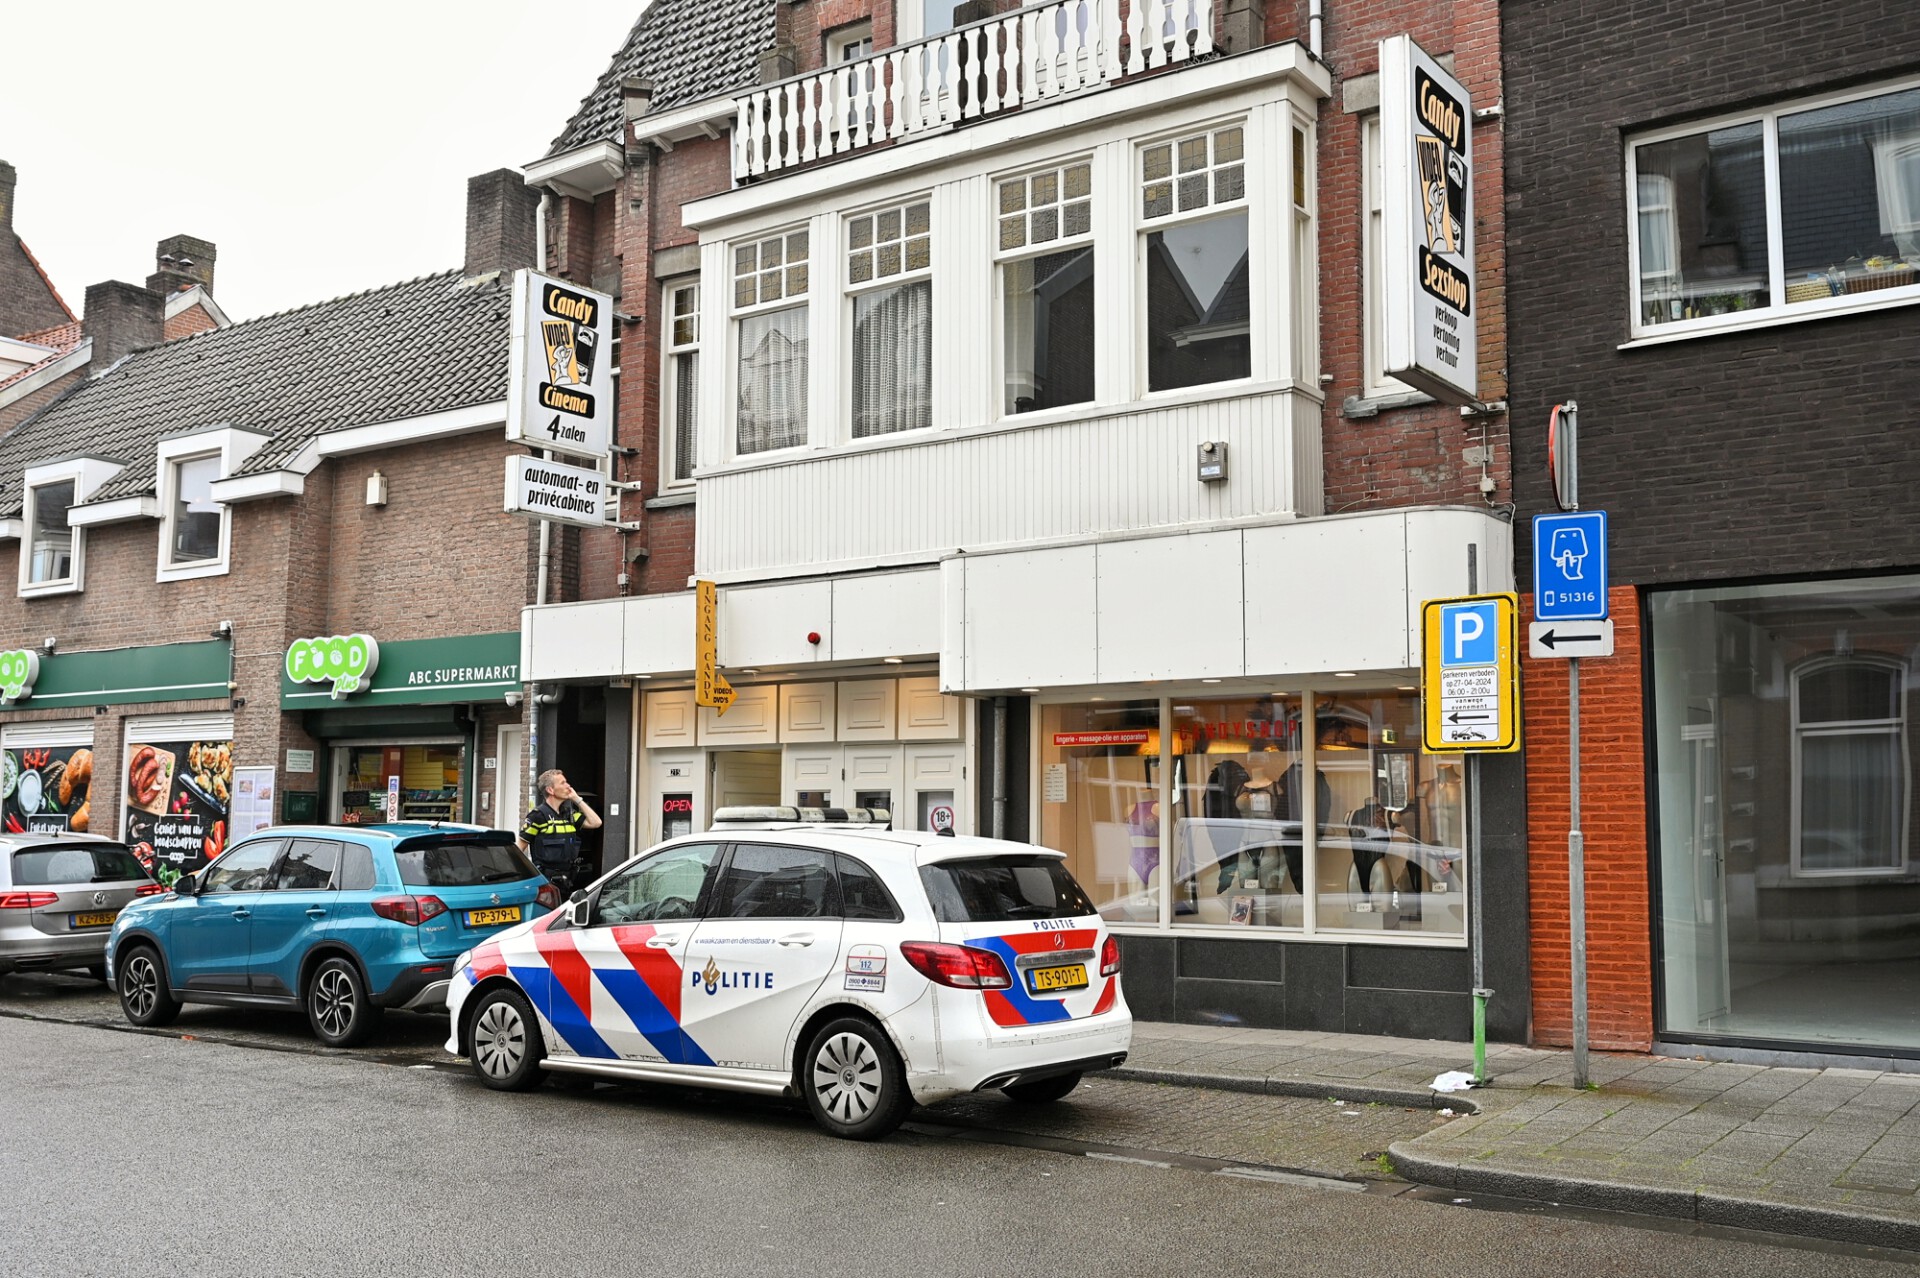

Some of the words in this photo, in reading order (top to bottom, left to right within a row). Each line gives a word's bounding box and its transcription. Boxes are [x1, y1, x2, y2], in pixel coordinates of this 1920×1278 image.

[1421, 79, 1460, 148] Candy
[1424, 253, 1467, 311] Sexshop
[549, 289, 593, 324] Candy
[1435, 305, 1458, 331] verkoop
[545, 323, 570, 346] VIDEO
[1433, 323, 1460, 352] vertoning
[1436, 345, 1458, 368] verhuur
[544, 386, 588, 414] Cinema
[547, 414, 560, 440] 4
[560, 425, 586, 442] zalen
[525, 468, 584, 491] automaat-
[585, 480, 599, 495] en
[527, 488, 595, 515] privécabines
[1560, 592, 1595, 603] 51316
[703, 586, 711, 643] INGANG
[1455, 612, 1484, 659] P
[294, 645, 362, 672] FOOD
[408, 670, 432, 685] ABC
[434, 665, 518, 683] SUPERMARKT
[703, 652, 711, 699] CANDY
[1443, 671, 1468, 679] parkeren
[1468, 669, 1496, 678] verboden
[333, 675, 359, 698] plus
[713, 687, 733, 695] VIDEOS
[1179, 719, 1297, 741] CANDYSHOP
[663, 799, 693, 812] OPEN
[936, 811, 951, 823] 18+
[154, 822, 176, 835] Geniet
[178, 824, 192, 835] van
[192, 826, 204, 835] uw
[154, 835, 202, 849] boodschappen
[474, 909, 516, 924] ZP-379-L
[1033, 919, 1076, 931] POLITIE
[738, 937, 771, 945] dienstbaar
[860, 960, 872, 968] 112
[692, 971, 774, 995] POLITIE
[1039, 968, 1081, 987] TS-901-T
